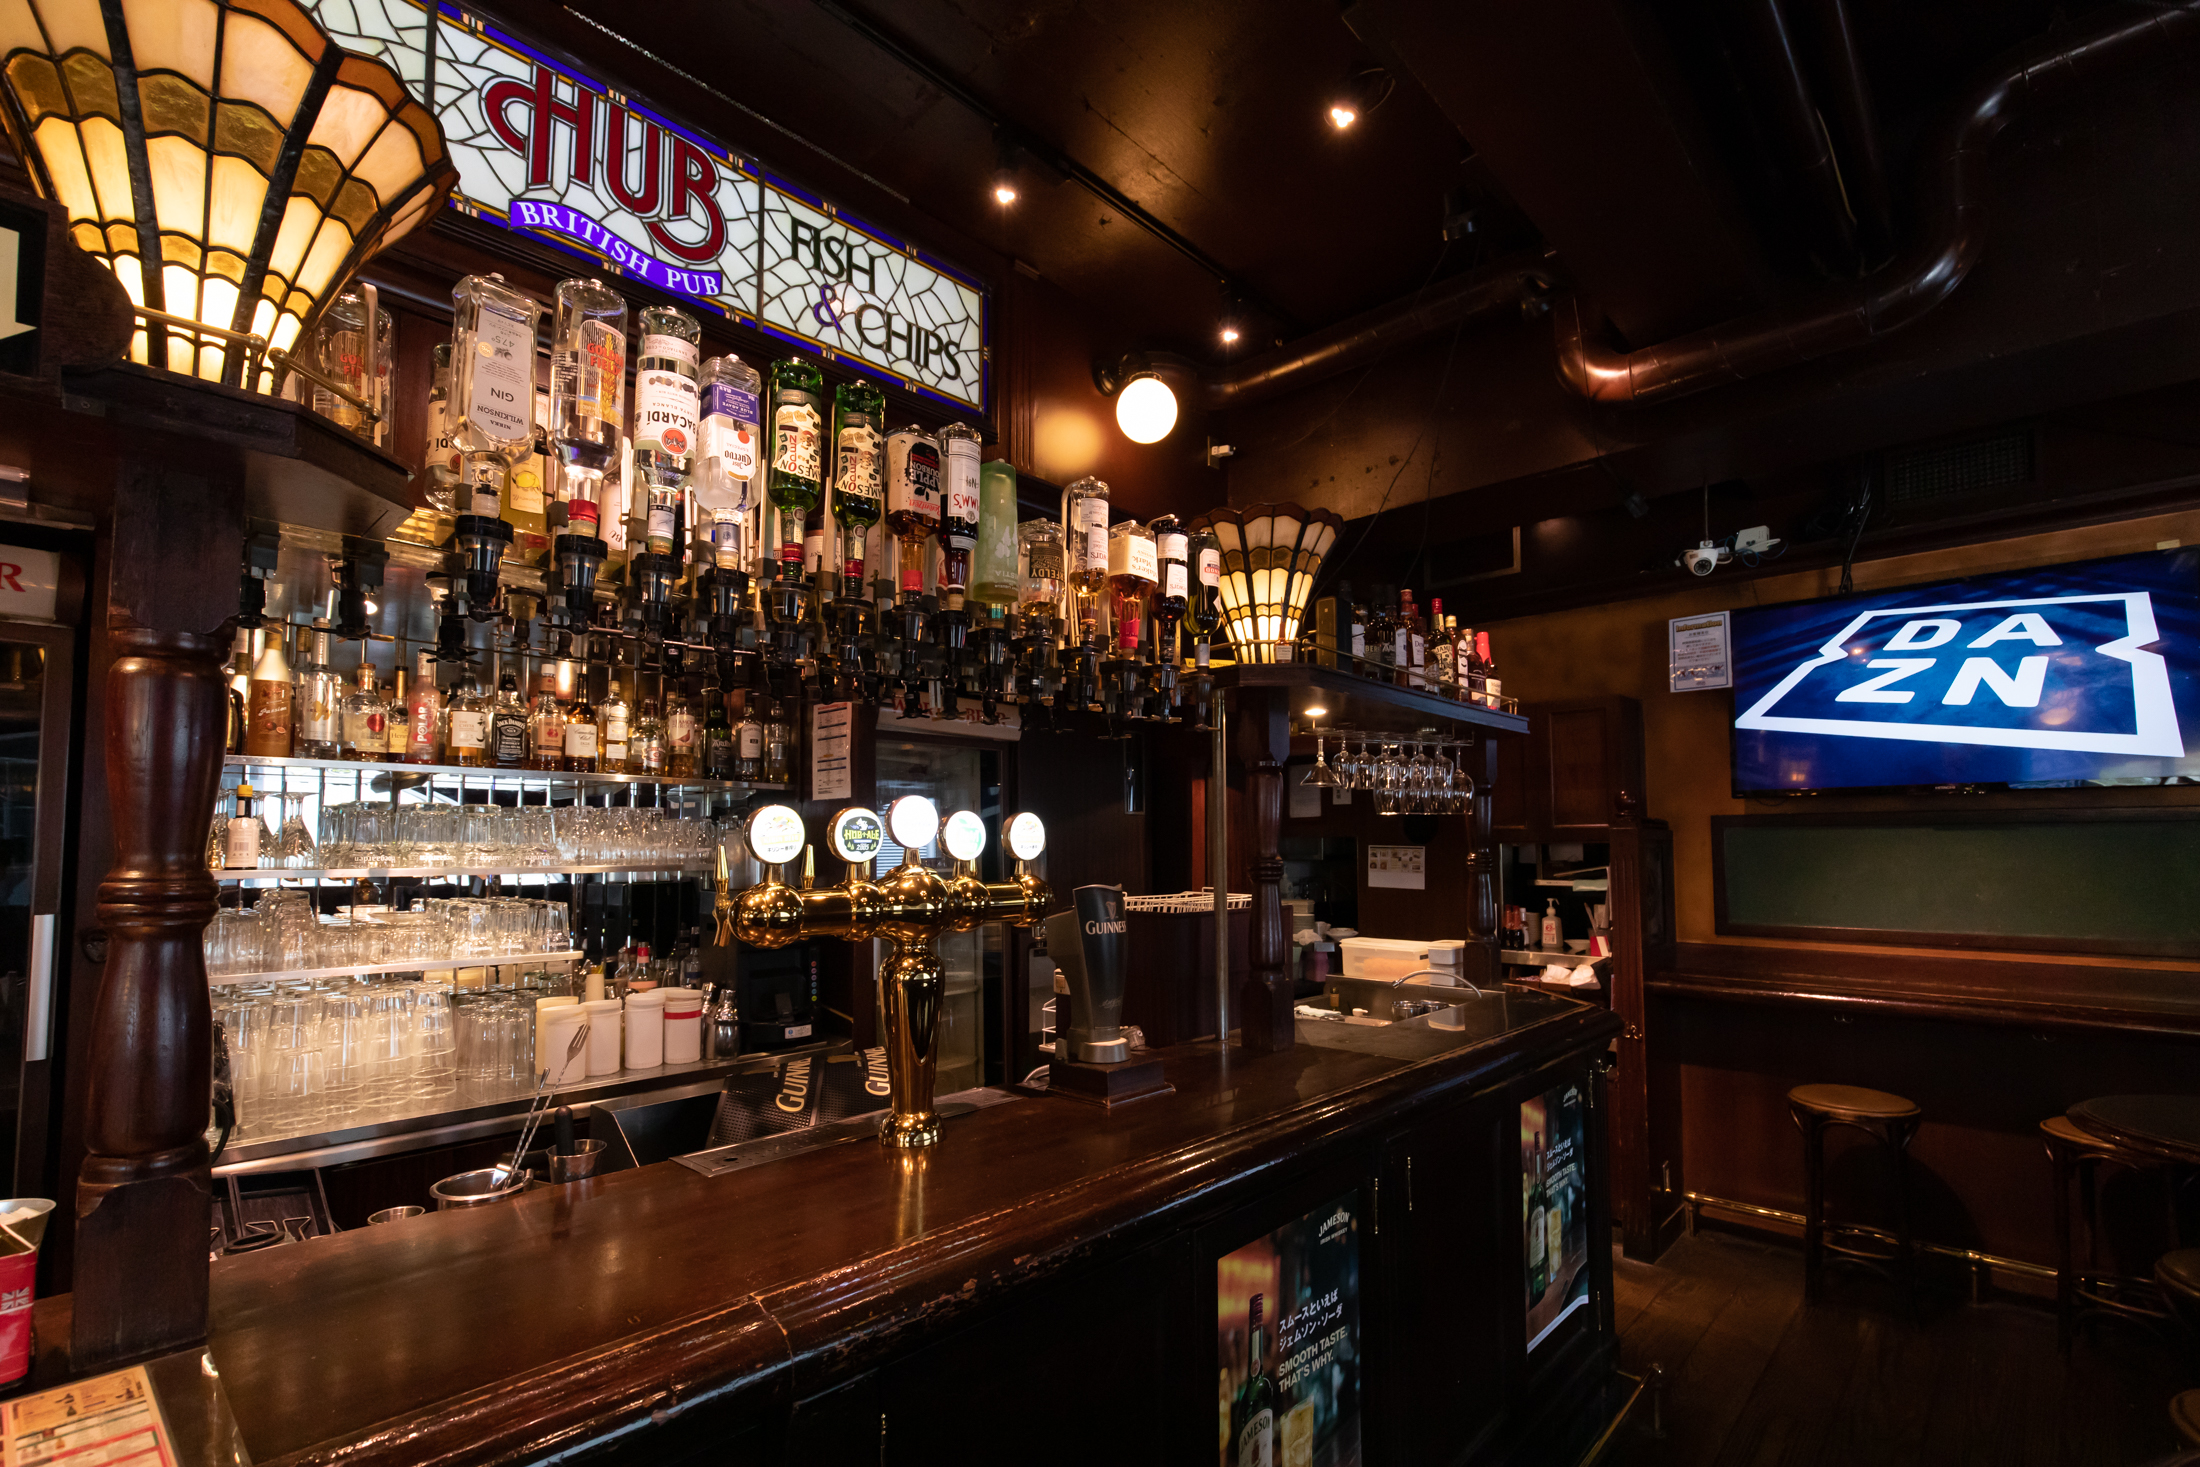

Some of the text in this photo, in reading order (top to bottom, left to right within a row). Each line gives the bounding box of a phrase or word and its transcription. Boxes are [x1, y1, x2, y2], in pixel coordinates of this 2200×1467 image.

[479, 64, 729, 267] HUB
[515, 199, 721, 297] BRITISH PUB
[789, 216, 877, 294] FISH
[812, 283, 962, 382] & CHIPS
[586, 342, 624, 370] GOLDEN
[490, 387, 514, 403] GIN
[652, 401, 678, 411] BLANCA
[476, 404, 524, 426] WILKINSON
[489, 419, 512, 431] NIKKA
[724, 449, 752, 467] Cuervo
[911, 462, 940, 478] OURBON
[840, 479, 882, 499] AMESON
[1883, 613, 2064, 651] DA
[1835, 655, 2050, 707] ZN
[257, 705, 288, 717] Passion
[416, 706, 428, 742] POLAR
[844, 829, 863, 841] HUB
[1085, 920, 1127, 935] GUINNESS
[1318, 1211, 1350, 1237] JAMESON
[1279, 1287, 1339, 1334] スムースといえば
[1279, 1302, 1343, 1353] ジェムソン・ソーダ
[1278, 1325, 1348, 1377] SMOOTH TASTE.
[1278, 1349, 1334, 1394] THAT'S WHY.
[1240, 1415, 1271, 1456] JAMESON
